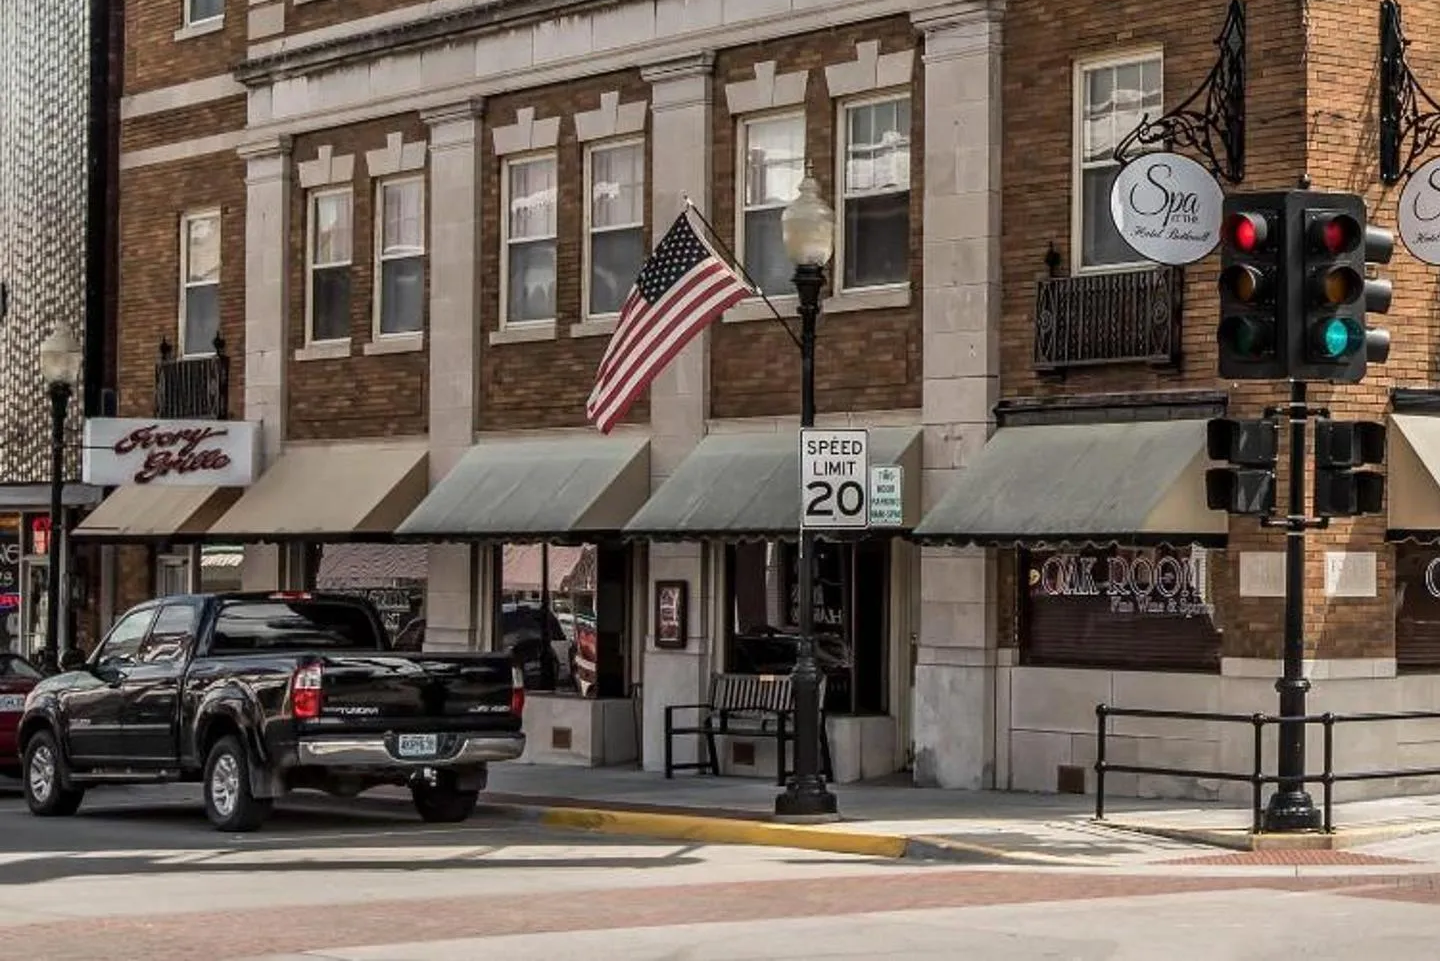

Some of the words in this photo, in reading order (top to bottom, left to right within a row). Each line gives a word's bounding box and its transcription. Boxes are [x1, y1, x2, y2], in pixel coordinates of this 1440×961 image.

[1129, 163, 1200, 231] Spa
[1130, 225, 1164, 238] Hotel
[114, 424, 229, 457] Ivory
[807, 440, 863, 455] SPEED
[134, 447, 232, 484] Grille
[813, 461, 856, 476] LIMIT
[806, 480, 865, 516] 20
[1042, 555, 1099, 595] OAK
[1106, 555, 1203, 597] ROOM
[1135, 595, 1165, 613] Wine
[1167, 597, 1177, 613] &
